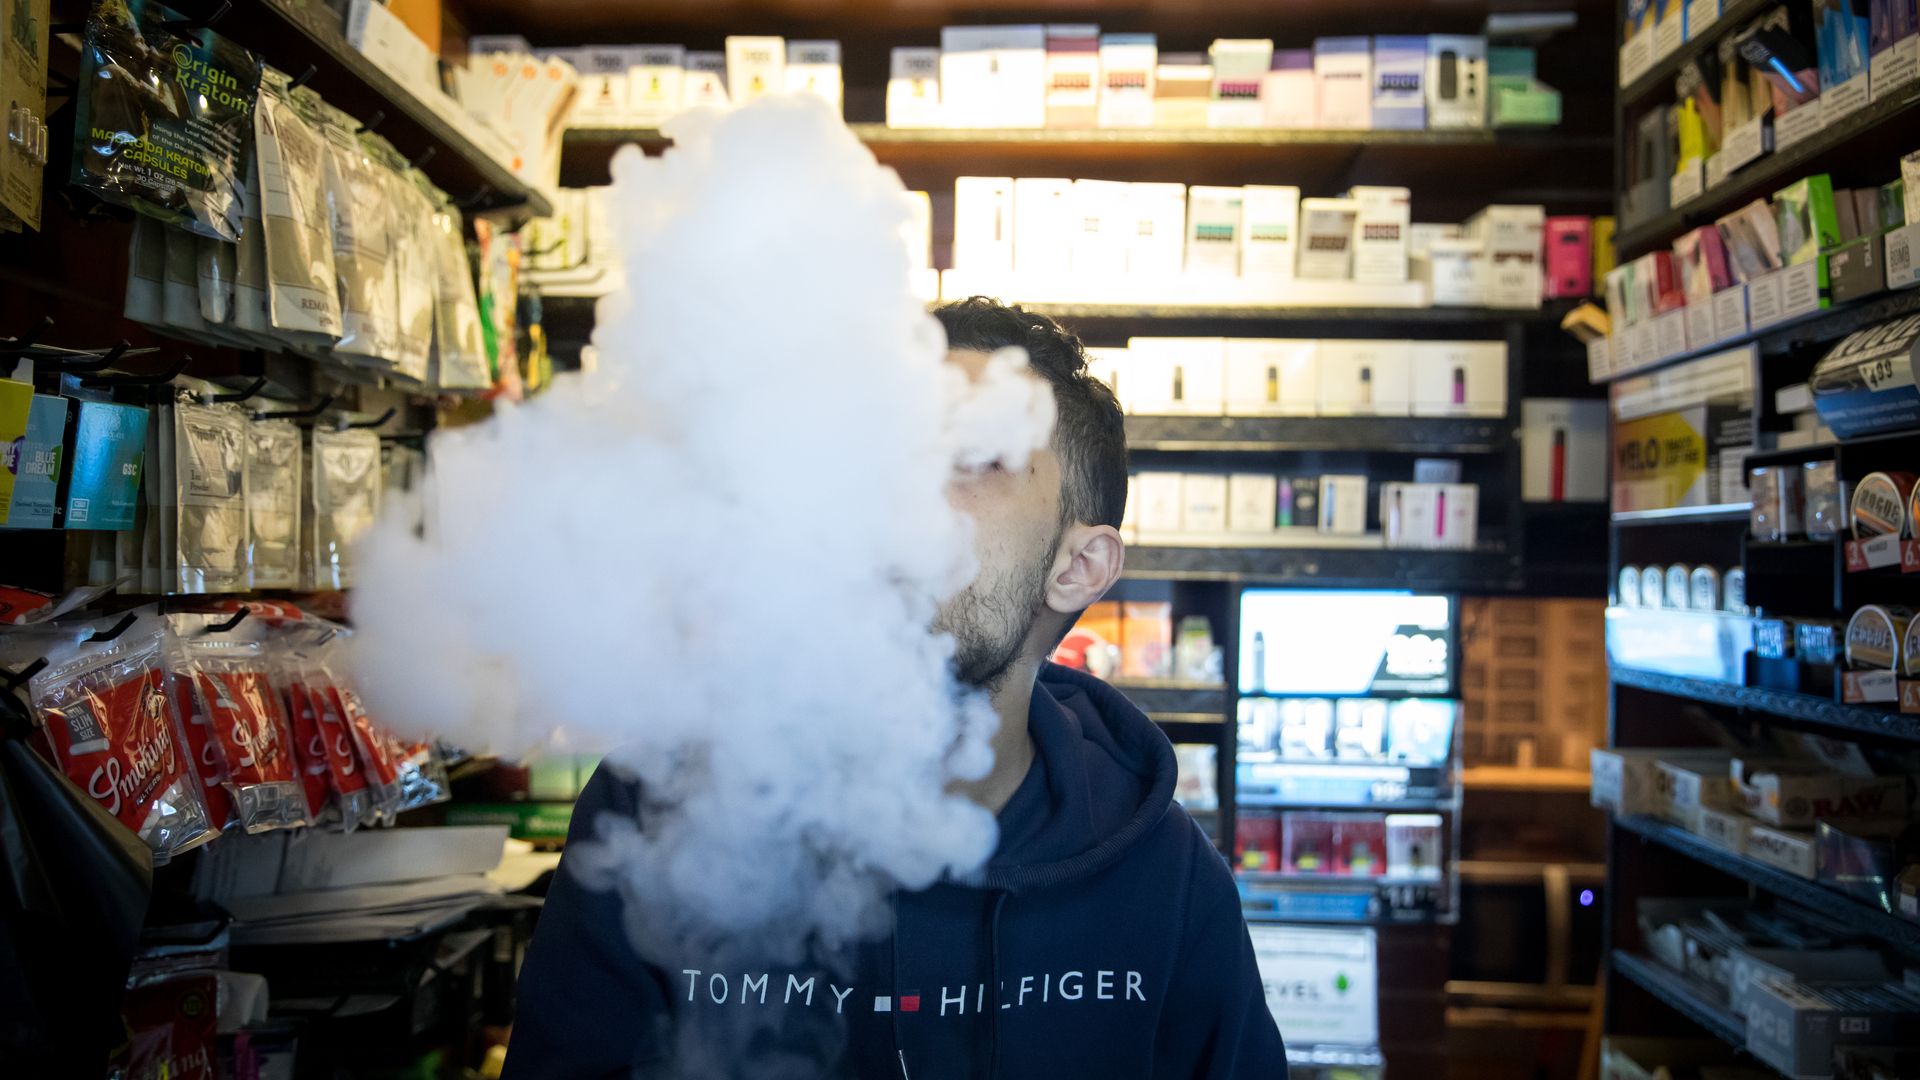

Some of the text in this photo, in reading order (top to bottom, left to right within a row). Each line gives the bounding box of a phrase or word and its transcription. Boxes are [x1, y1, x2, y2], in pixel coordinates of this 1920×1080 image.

[173, 44, 238, 90] Origin
[176, 66, 249, 115] Kratom
[123, 148, 189, 180] CAPSULES
[165, 149, 211, 178] KRATOM
[25, 462, 55, 476] DREAM
[35, 451, 56, 464] BLUE
[122, 463, 138, 476] GSC
[1860, 489, 1901, 522] ROGUE
[70, 712, 94, 733] SLIM
[79, 727, 96, 741] SIZE
[88, 725, 175, 816] Smoking
[1813, 788, 1884, 818] RAW
[682, 968, 1147, 1016] TOMMY HILFIGER
[1750, 1001, 1792, 1047] OCB
